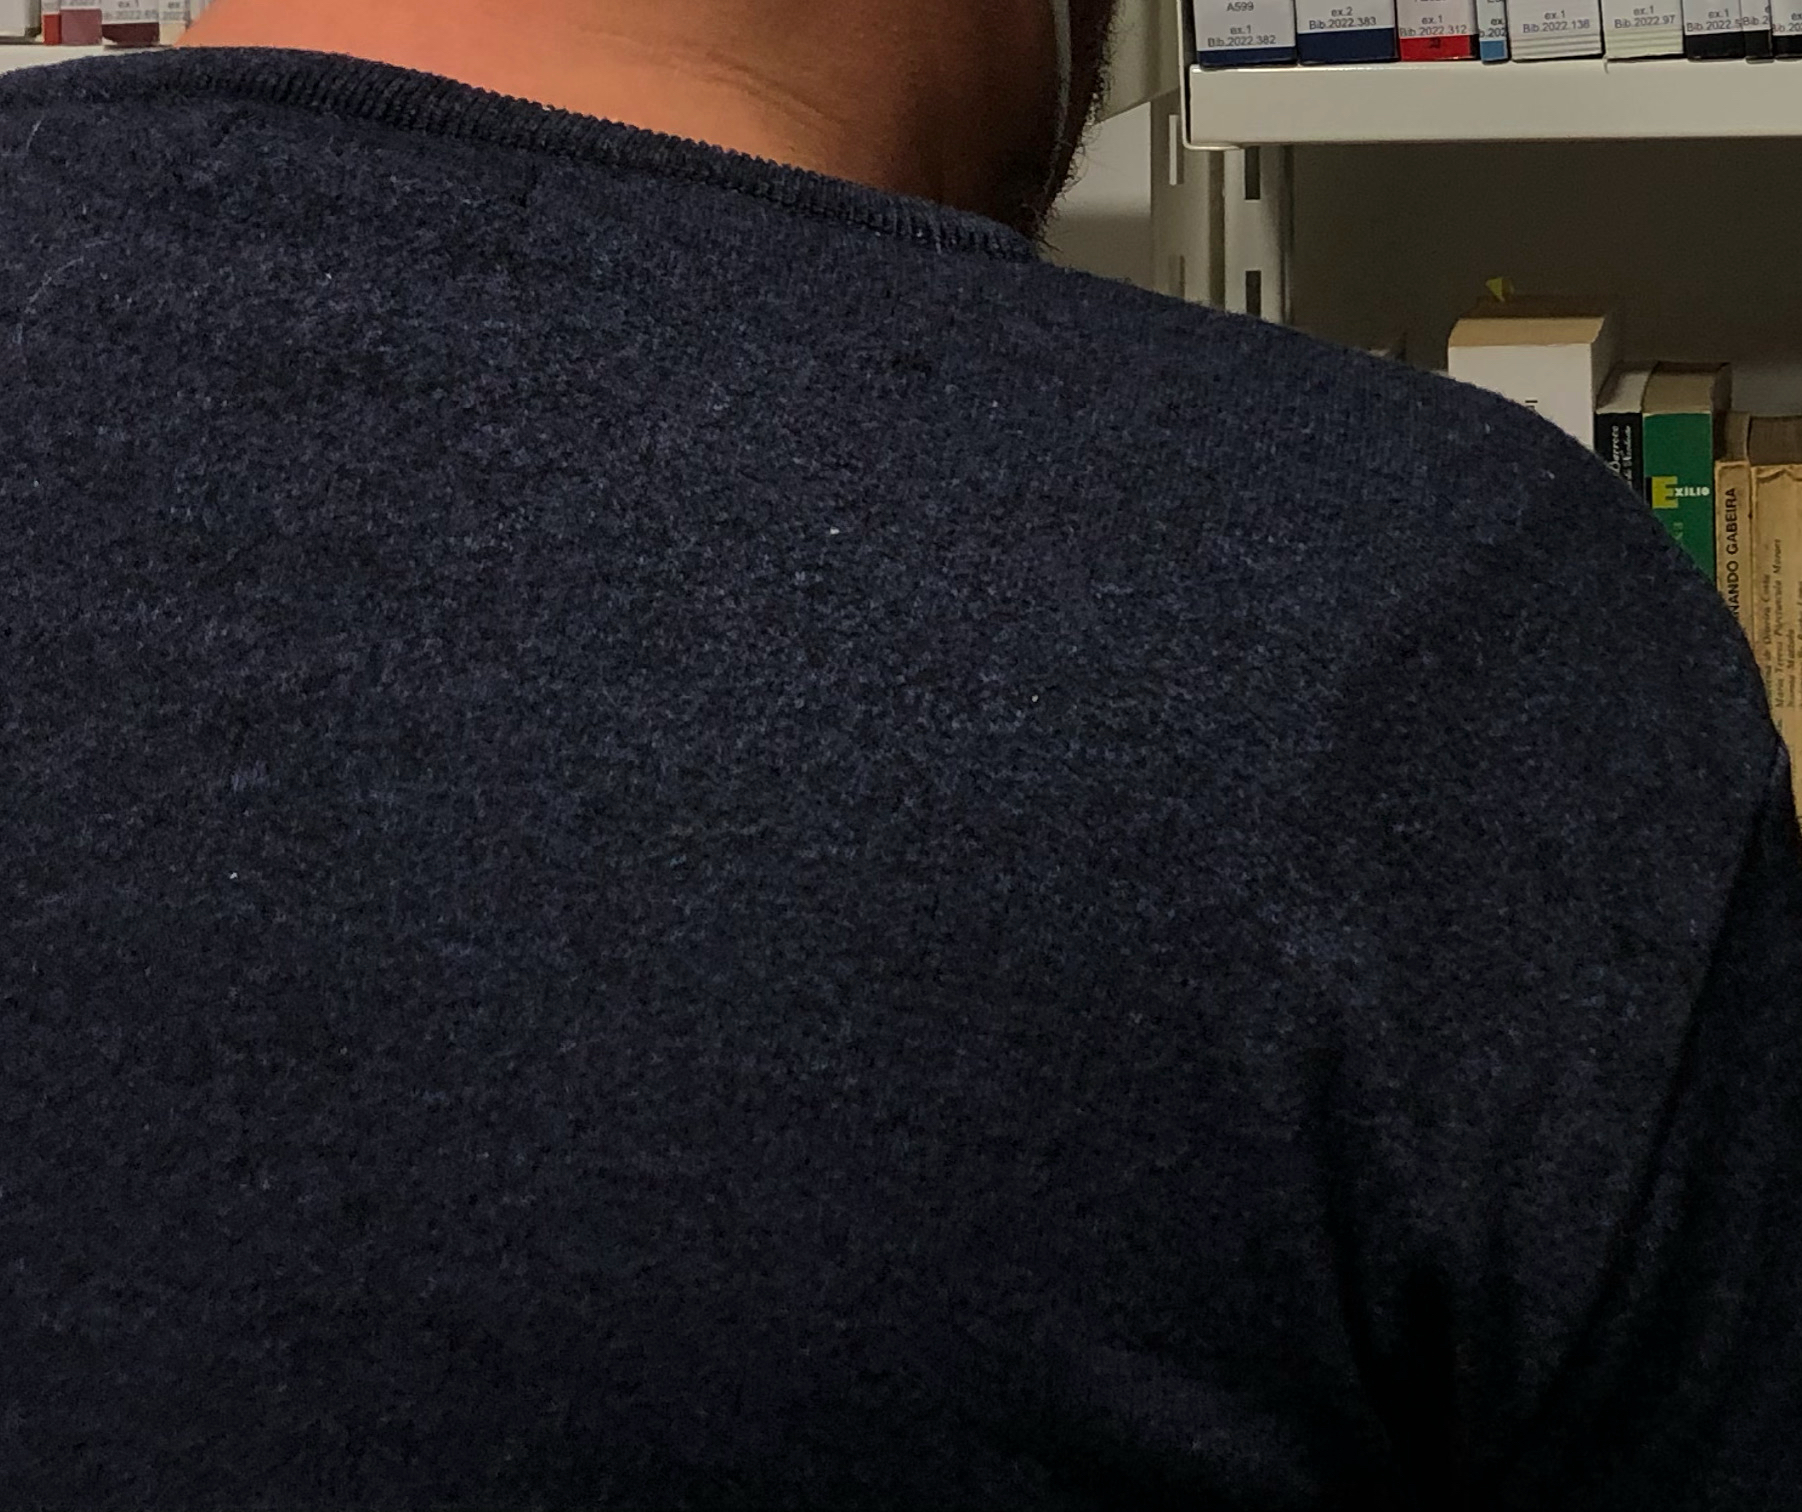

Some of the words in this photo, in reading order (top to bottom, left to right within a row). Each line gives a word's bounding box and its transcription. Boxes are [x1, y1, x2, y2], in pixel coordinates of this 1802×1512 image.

[1633, 5, 1657, 16] ex.1
[1614, 15, 1676, 29] Bib.2022.97
[1725, 488, 1738, 554] GABEIRA
